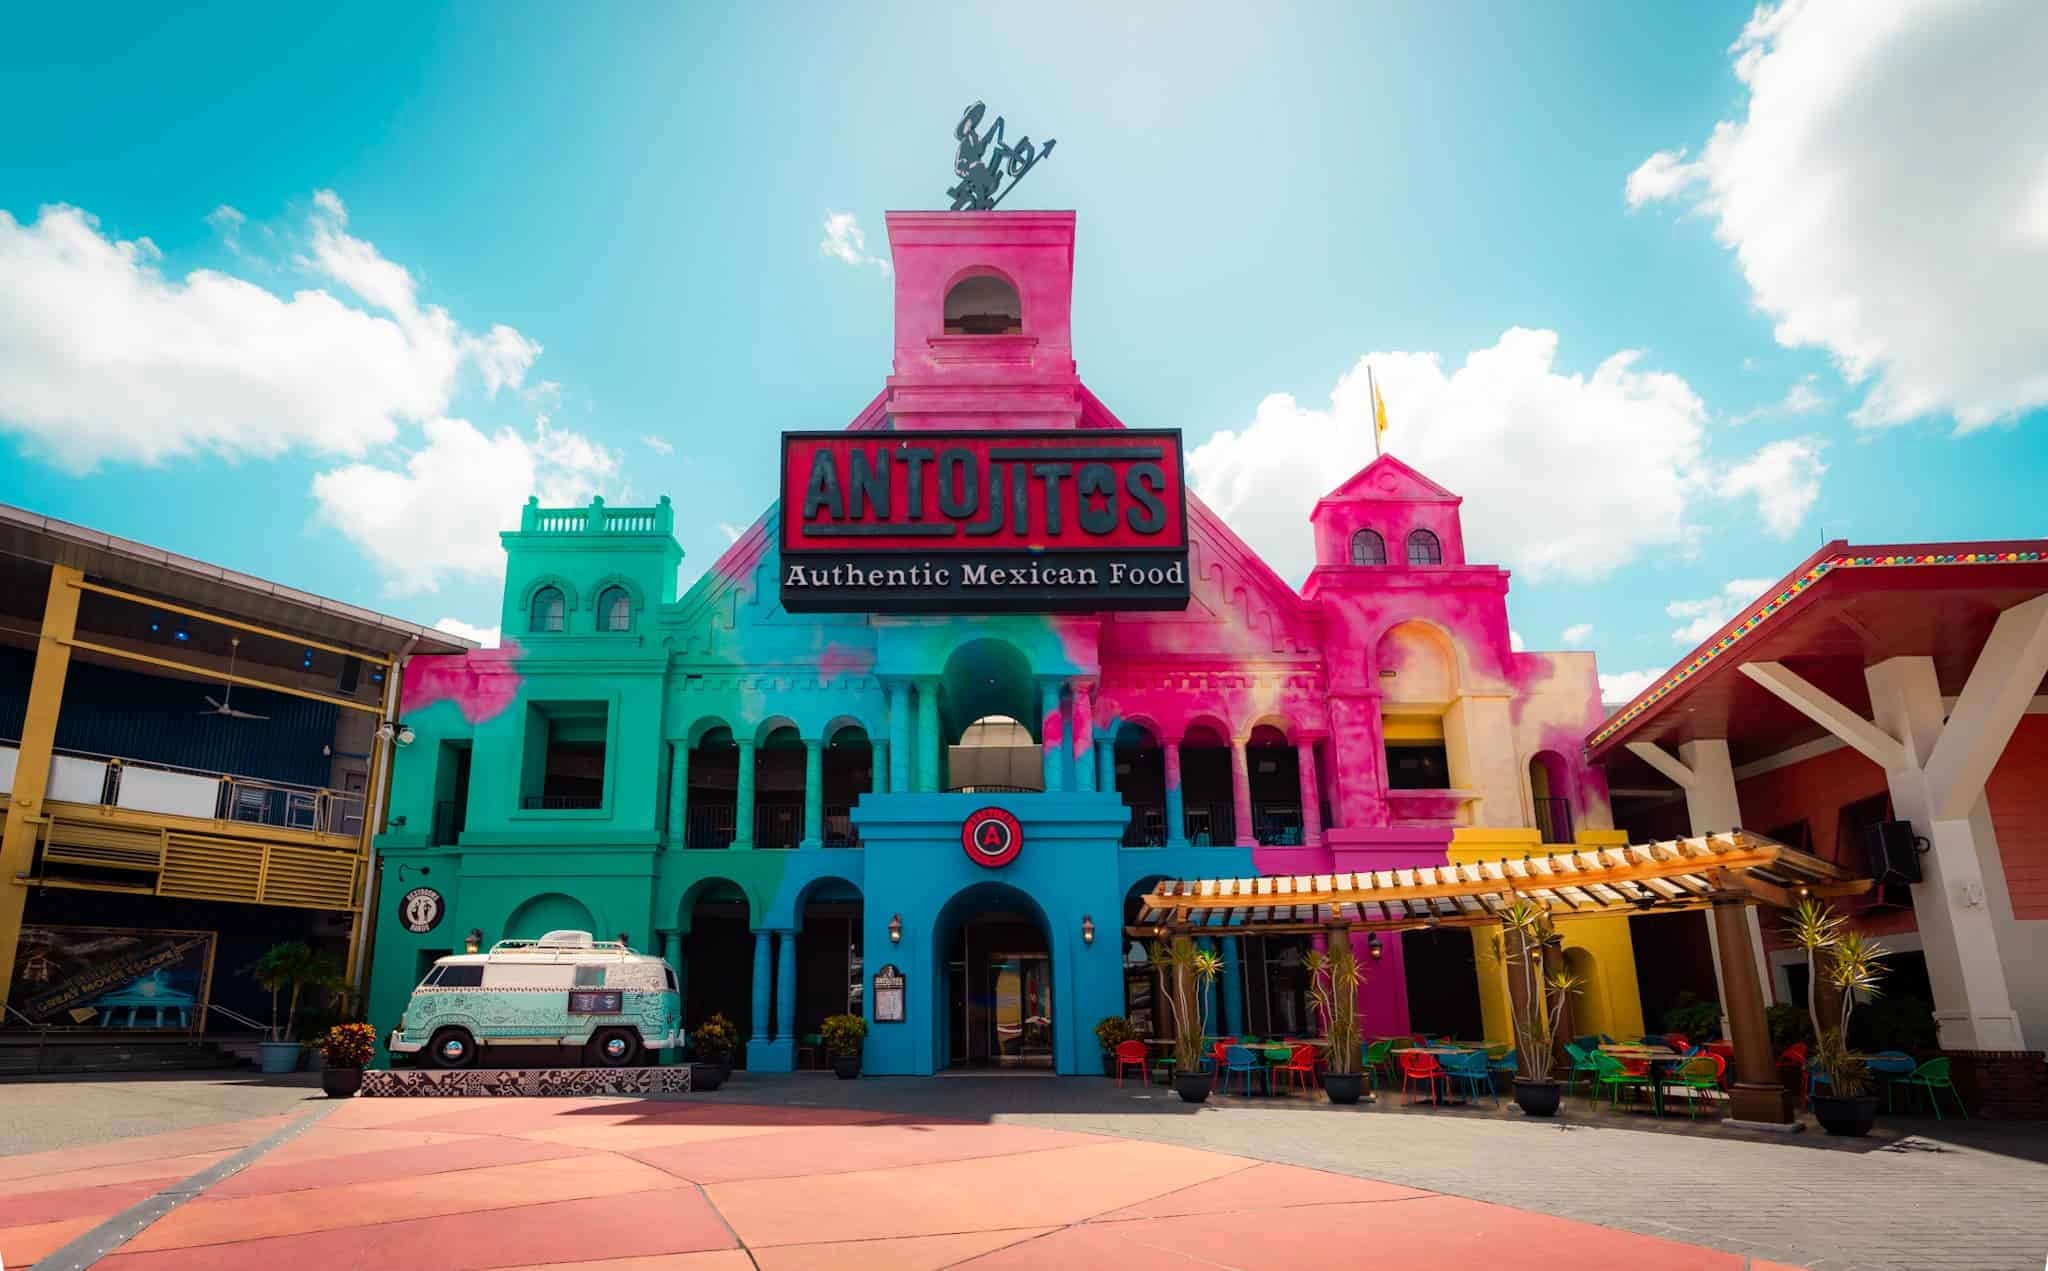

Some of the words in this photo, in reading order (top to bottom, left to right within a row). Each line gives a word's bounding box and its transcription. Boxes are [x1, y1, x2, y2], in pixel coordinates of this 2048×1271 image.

[802, 447, 1167, 536] ANTOJITOS
[784, 562, 951, 587] Authentic
[961, 561, 1098, 586] Mexican
[1109, 561, 1185, 585] Food
[983, 825, 1002, 846] A
